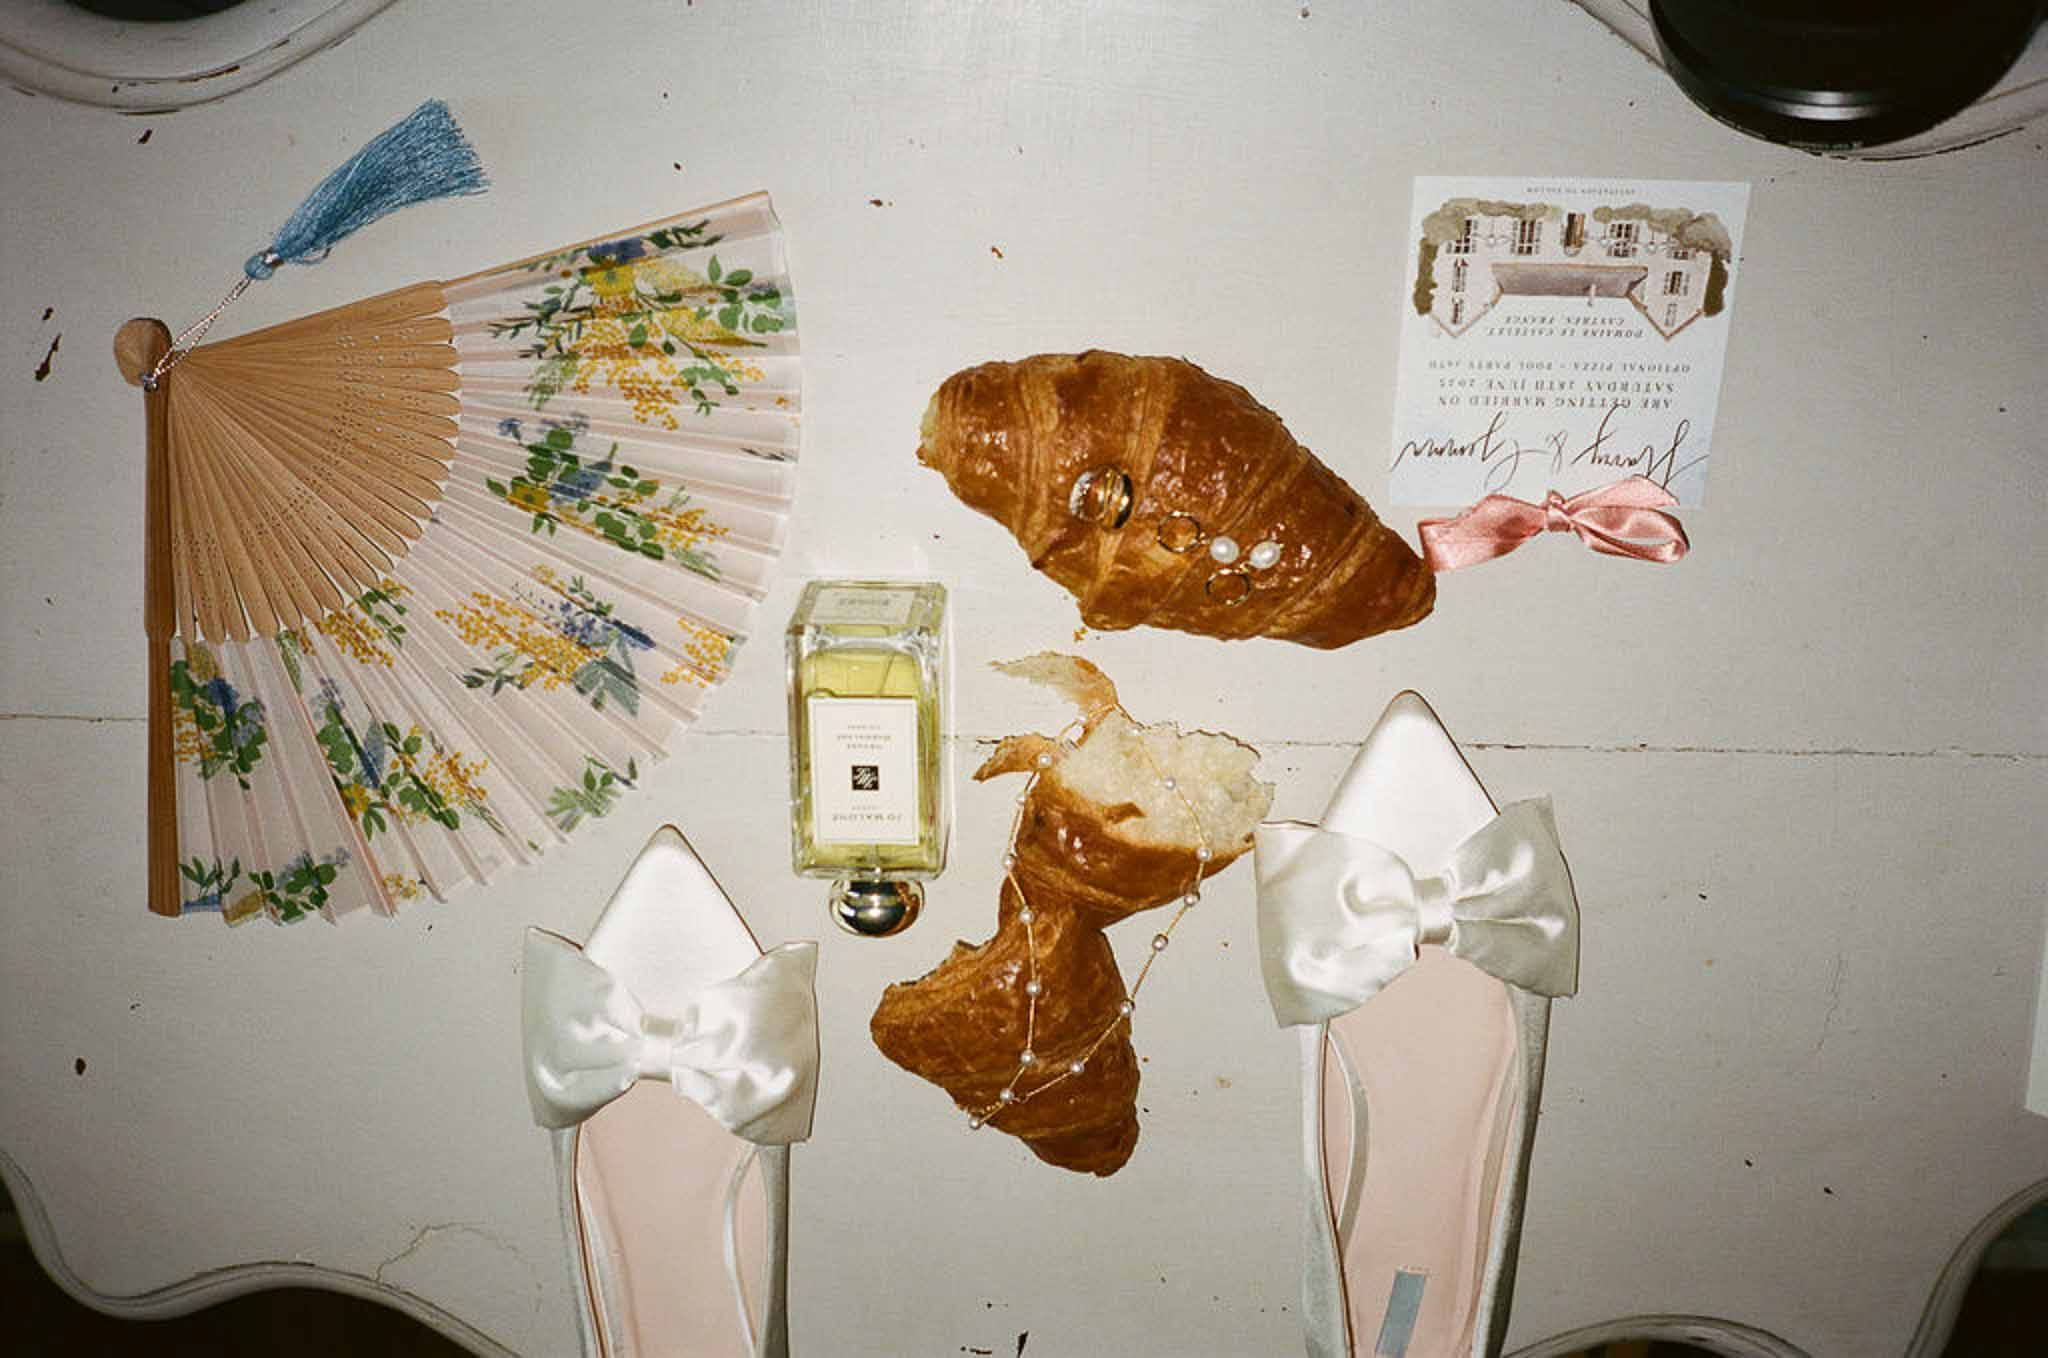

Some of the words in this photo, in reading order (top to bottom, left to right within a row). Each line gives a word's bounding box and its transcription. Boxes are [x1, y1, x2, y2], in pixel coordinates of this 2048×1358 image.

[1504, 315, 1556, 326] FRANCE
[1583, 327, 1644, 338] DOMAINE
[1469, 360, 1512, 371] PARTY
[1519, 360, 1554, 371] POOL
[1572, 361, 1614, 373] PIZZA
[1621, 362, 1692, 374] OPTIONAL
[1488, 378, 1528, 391] JUNE
[1586, 379, 1675, 393] SATURDAY
[1438, 396, 1460, 407] ON
[1469, 396, 1547, 409] MARRIED
[1554, 397, 1632, 409] GETTING
[1642, 399, 1674, 409] ARE
[1390, 410, 1550, 492] Gemma
[1546, 429, 1569, 475] &
[832, 812, 884, 822] MALONE
